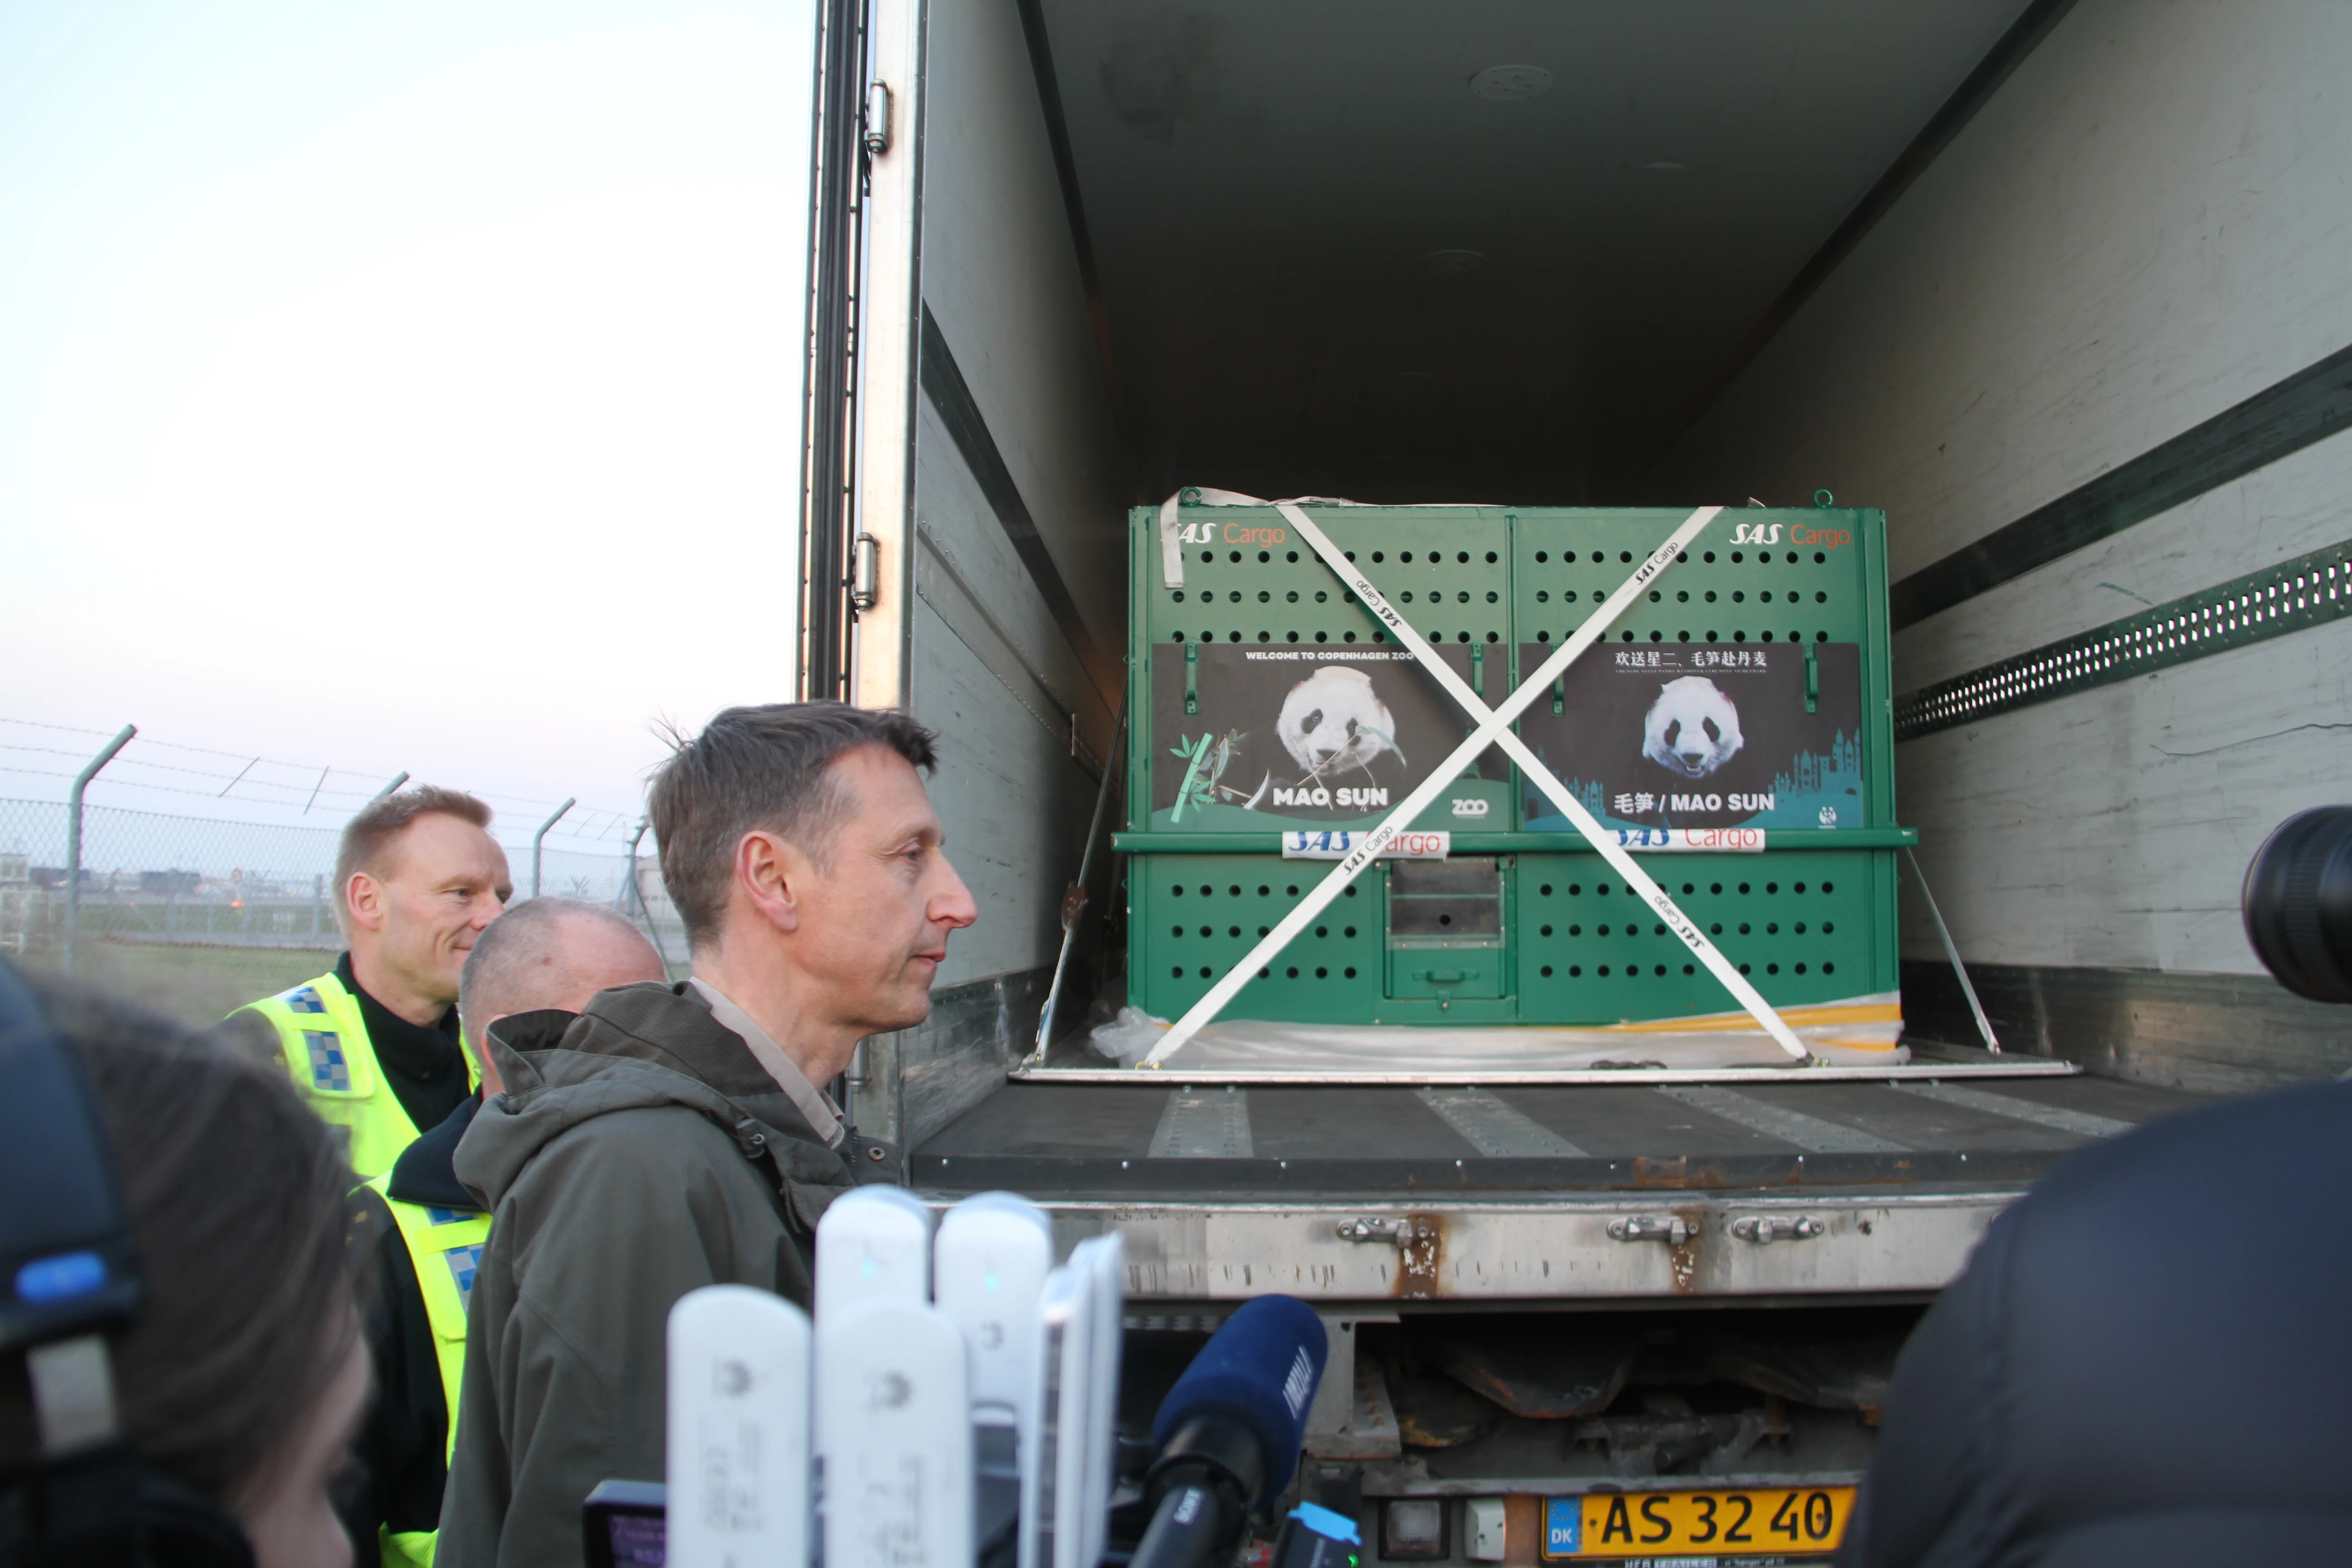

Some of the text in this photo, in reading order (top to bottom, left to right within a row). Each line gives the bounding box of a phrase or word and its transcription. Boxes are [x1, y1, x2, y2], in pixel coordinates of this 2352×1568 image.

[1160, 522, 1285, 548] AS Cargo
[1729, 523, 1850, 549] SAS Cargo
[1635, 542, 1678, 585] SAS Cargo
[1356, 580, 1402, 627] SAS Cargo
[1615, 651, 1767, 667] 欢送星二、毛笋赴丹麦
[1273, 788, 1387, 806] MAO SUN
[1452, 799, 1488, 814] ZOO
[1614, 793, 1654, 813] 毛笋
[1671, 794, 1722, 811] MAO
[1728, 794, 1775, 811] SUN
[1288, 831, 1441, 857] SAS argo
[1343, 826, 1393, 876] SAS Cargo
[1685, 829, 1757, 849] Cargo
[1654, 896, 1705, 947] SAS Cargo
[1601, 1492, 1833, 1544] AS 32 40
[1551, 1529, 1573, 1544] DK
